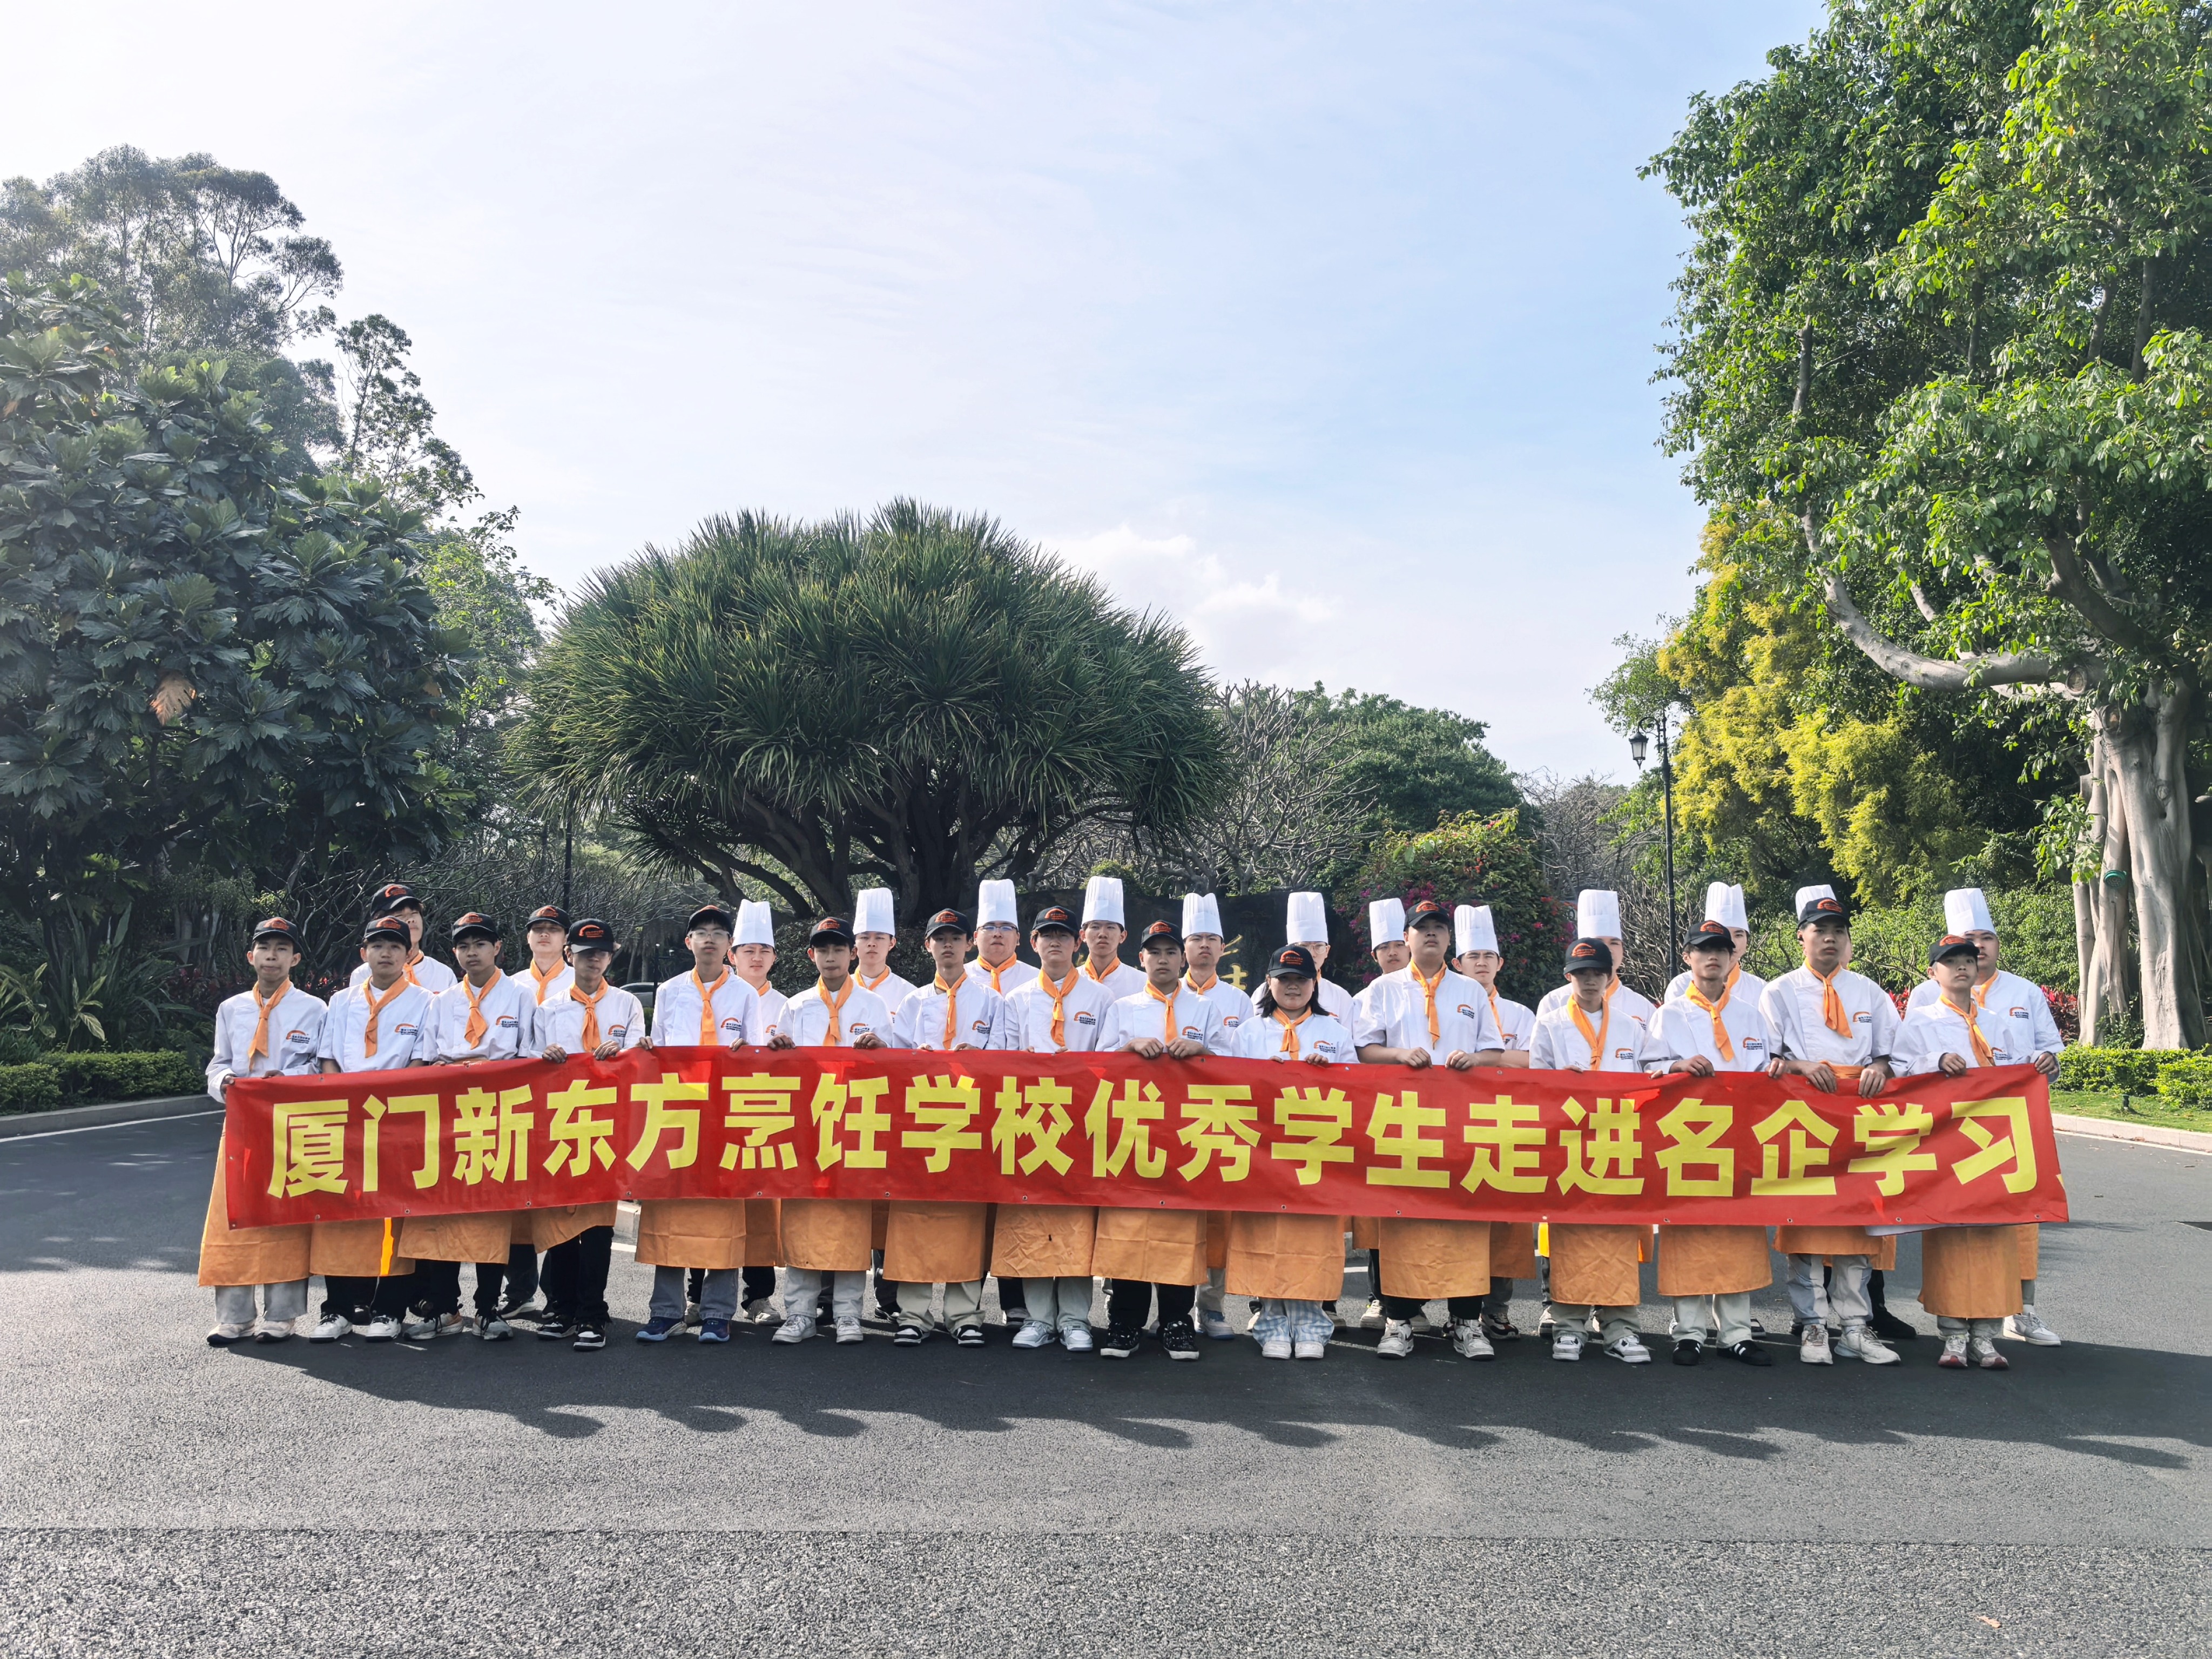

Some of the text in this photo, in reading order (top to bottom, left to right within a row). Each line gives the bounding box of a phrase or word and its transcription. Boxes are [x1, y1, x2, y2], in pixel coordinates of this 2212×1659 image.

[267, 1073, 2037, 1199] 厦门新东方烹饪学校优秀学生走进名企学习
